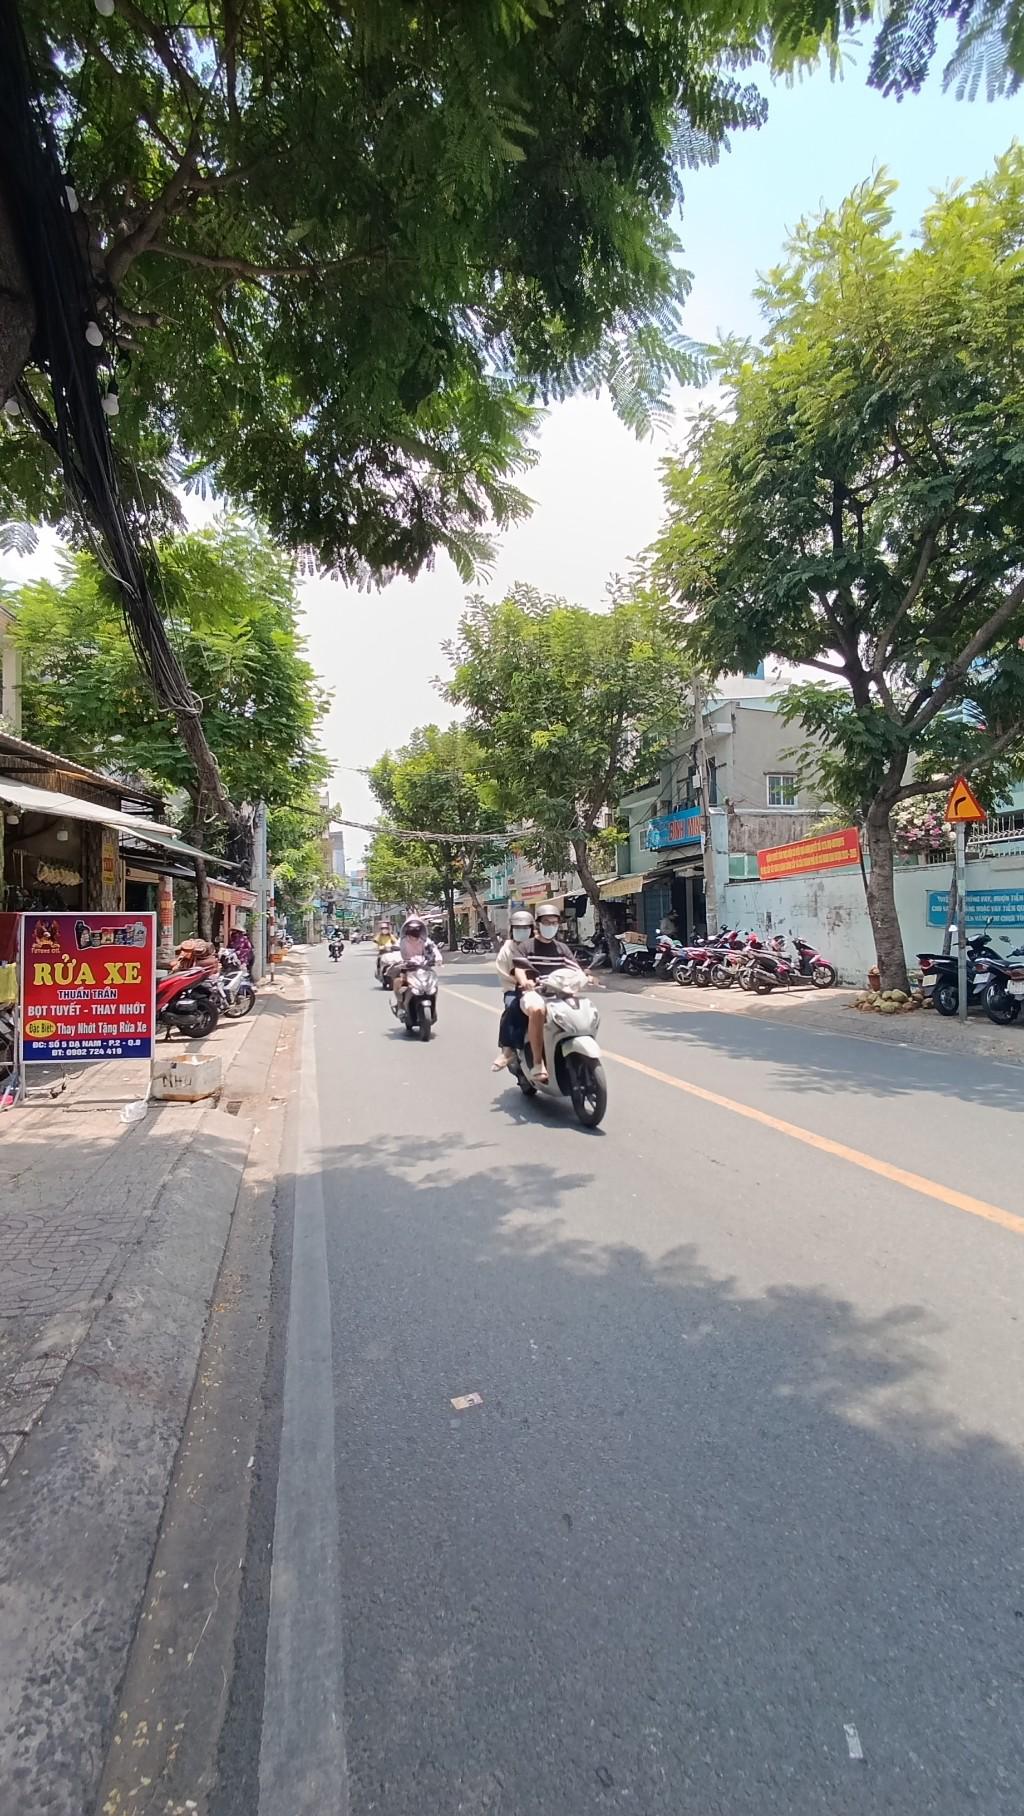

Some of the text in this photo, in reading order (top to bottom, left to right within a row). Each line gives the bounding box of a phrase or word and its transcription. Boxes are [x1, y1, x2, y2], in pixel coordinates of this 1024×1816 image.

[33, 954, 142, 985] RỬA XE
[50, 1001, 82, 1016] TUYẾT
[91, 1004, 116, 1014] THAY
[119, 1002, 146, 1014] NHỚT
[56, 1023, 76, 1036] Thay
[78, 1022, 96, 1034] Nhớt
[98, 1022, 118, 1036] Tặng
[120, 1020, 135, 1032] Rửa
[136, 1022, 147, 1032] Xe
[48, 1040, 60, 1048] SỐ
